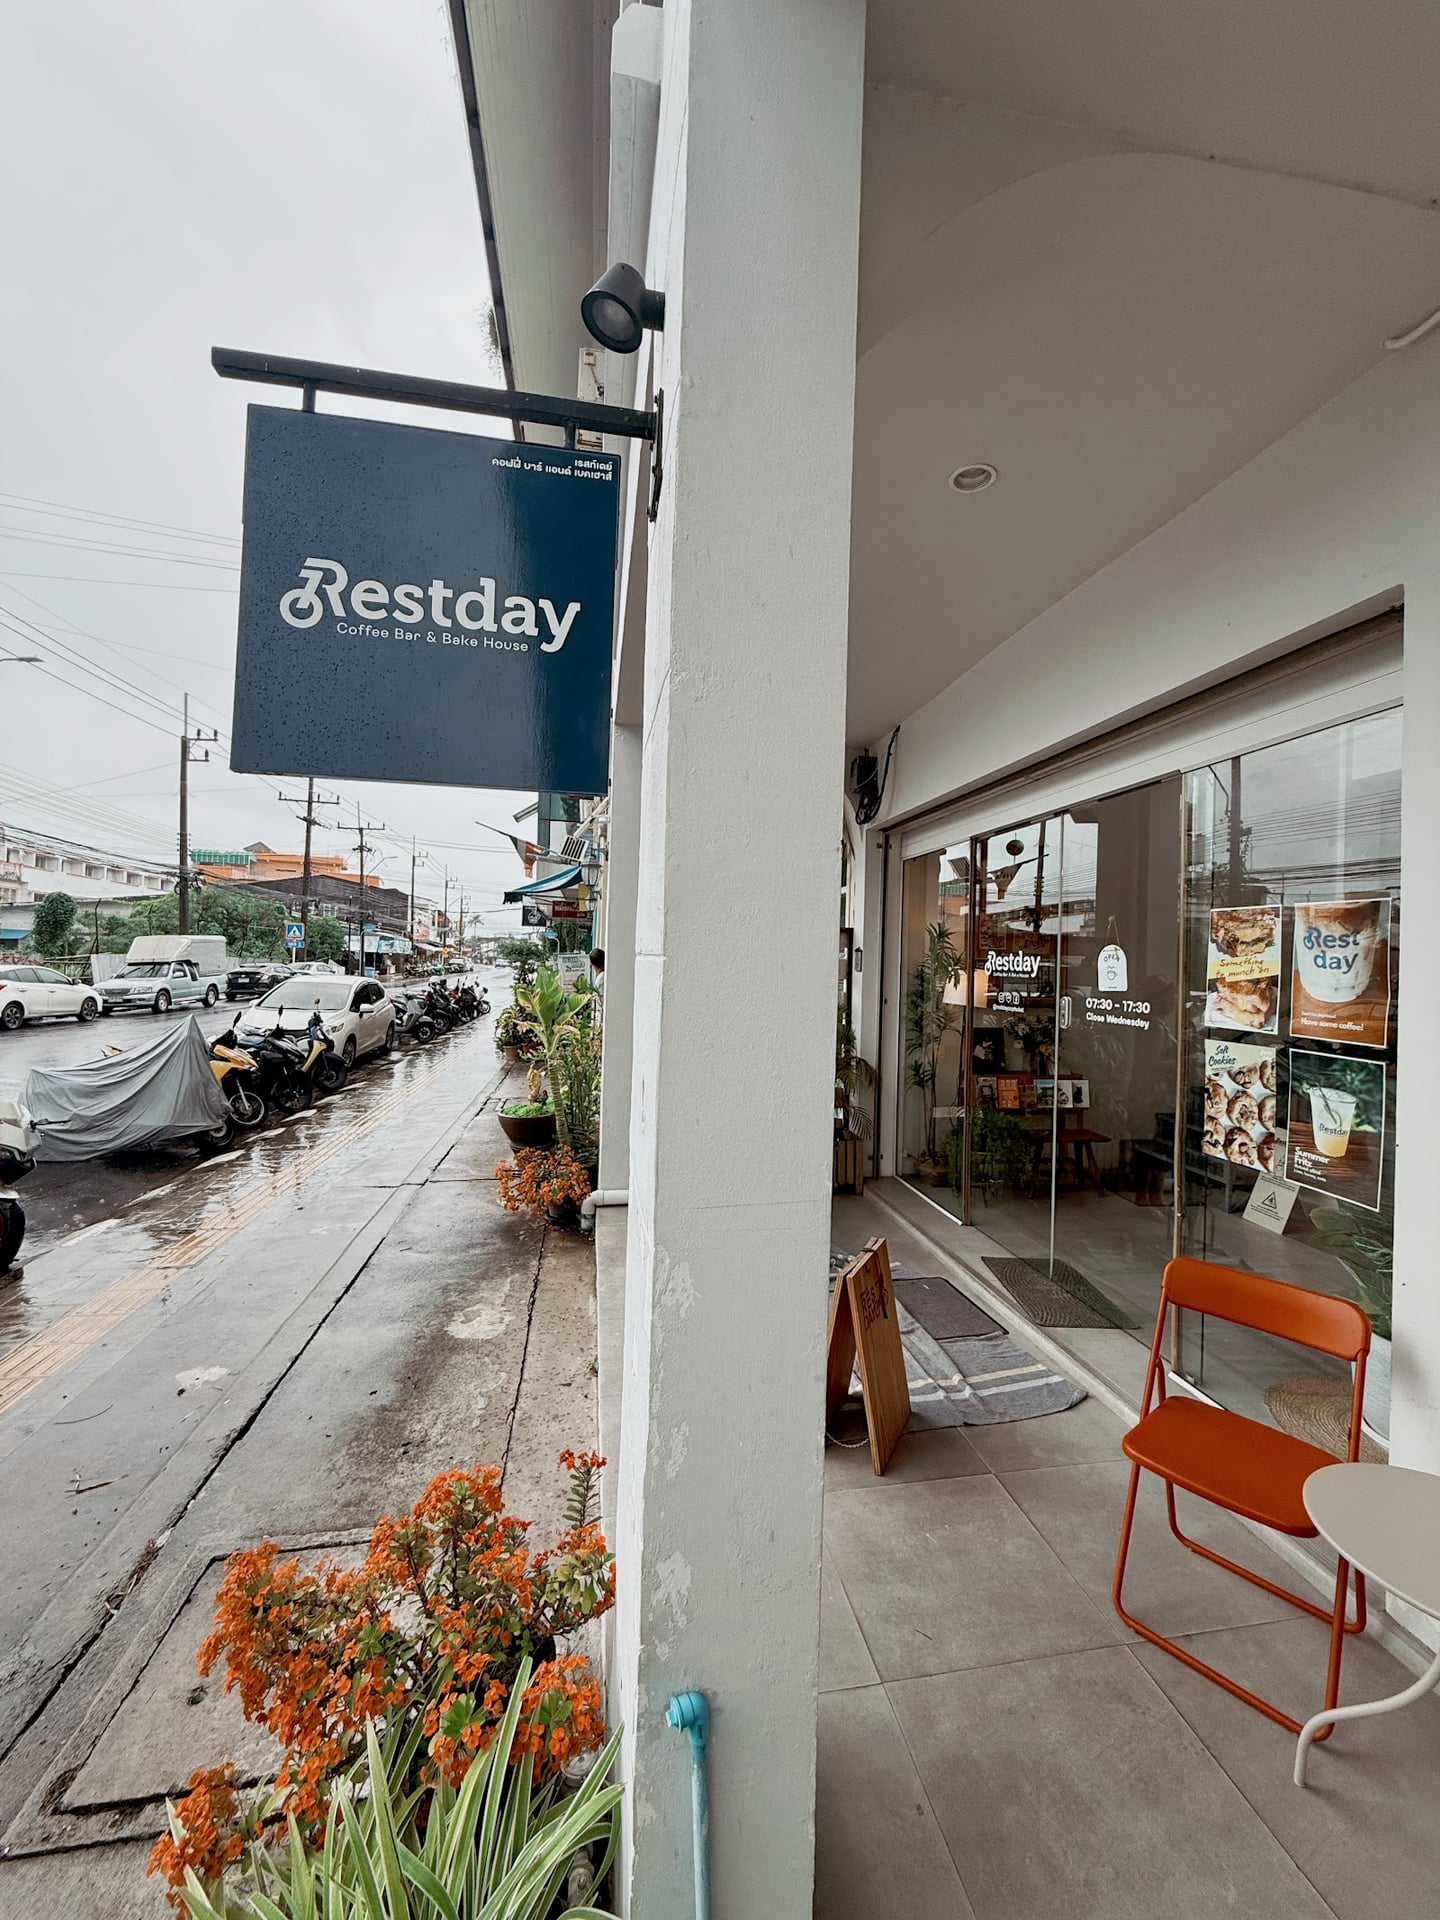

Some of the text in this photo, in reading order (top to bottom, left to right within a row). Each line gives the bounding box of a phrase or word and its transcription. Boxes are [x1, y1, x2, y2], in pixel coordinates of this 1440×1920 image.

[524, 461, 543, 472] บาร์
[546, 465, 572, 476] แอนด์
[280, 557, 581, 653] Restday
[336, 622, 528, 652] Coffee Bar & Bake House
[985, 950, 1040, 978] Restday
[1219, 955, 1264, 968] Something
[1313, 950, 1359, 975] day
[1085, 997, 1113, 1011] 07:30
[1122, 1000, 1151, 1014] 17:30
[1086, 1012, 1150, 1031] Close Wednesday
[1301, 1017, 1364, 1032] Have some coffee!
[1208, 1055, 1237, 1067] Cookies
[1295, 1147, 1330, 1164] Summer
